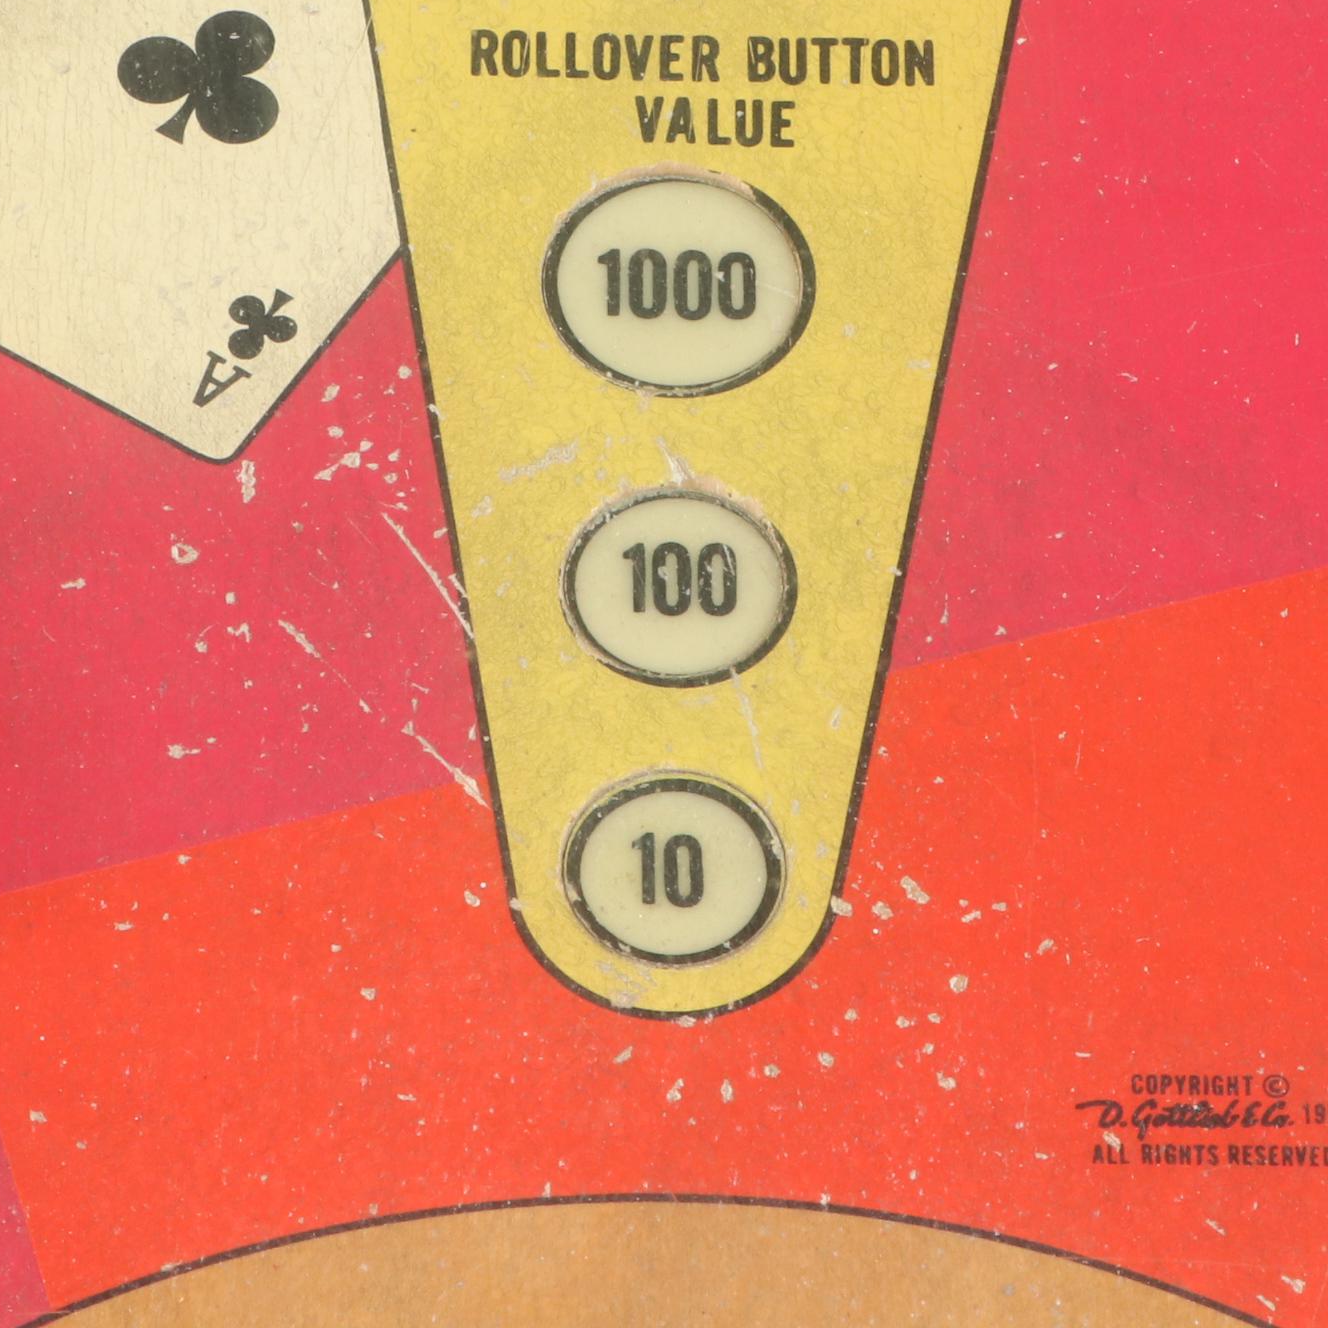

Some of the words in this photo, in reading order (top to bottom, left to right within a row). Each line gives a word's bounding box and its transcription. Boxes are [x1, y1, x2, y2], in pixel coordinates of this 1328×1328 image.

[470, 29, 721, 82] ROLLOVER
[748, 37, 935, 87] BUTTON
[635, 95, 796, 149] VALUE
[597, 248, 757, 321] 1000
[192, 349, 253, 408] A
[622, 541, 738, 617] 100
[631, 832, 705, 908] 10
[1075, 1099, 1128, 1129] D.
[1130, 1074, 1254, 1096] COPYRIGHT
[1092, 1144, 1130, 1165] ALL
[1141, 1144, 1219, 1166] RIGHTS
